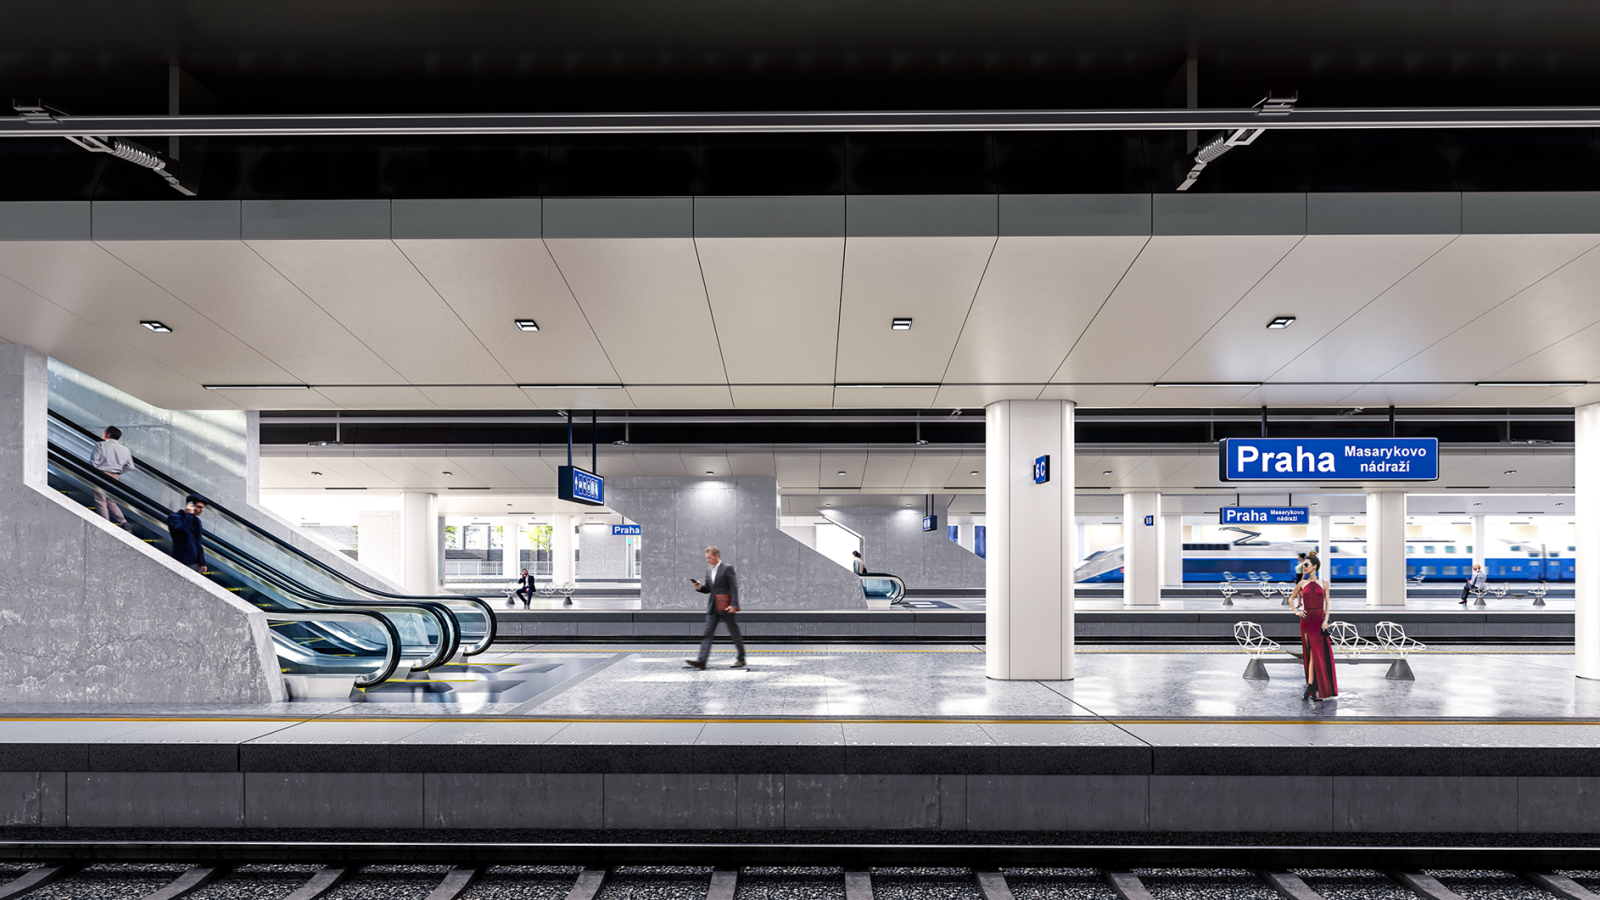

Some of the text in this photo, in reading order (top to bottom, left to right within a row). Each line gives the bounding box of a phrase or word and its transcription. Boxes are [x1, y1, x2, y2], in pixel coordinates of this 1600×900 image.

[1237, 445, 1427, 472] Praha Masarykovo
[1360, 460, 1410, 472] nádraží
[1226, 510, 1268, 522] Praha
